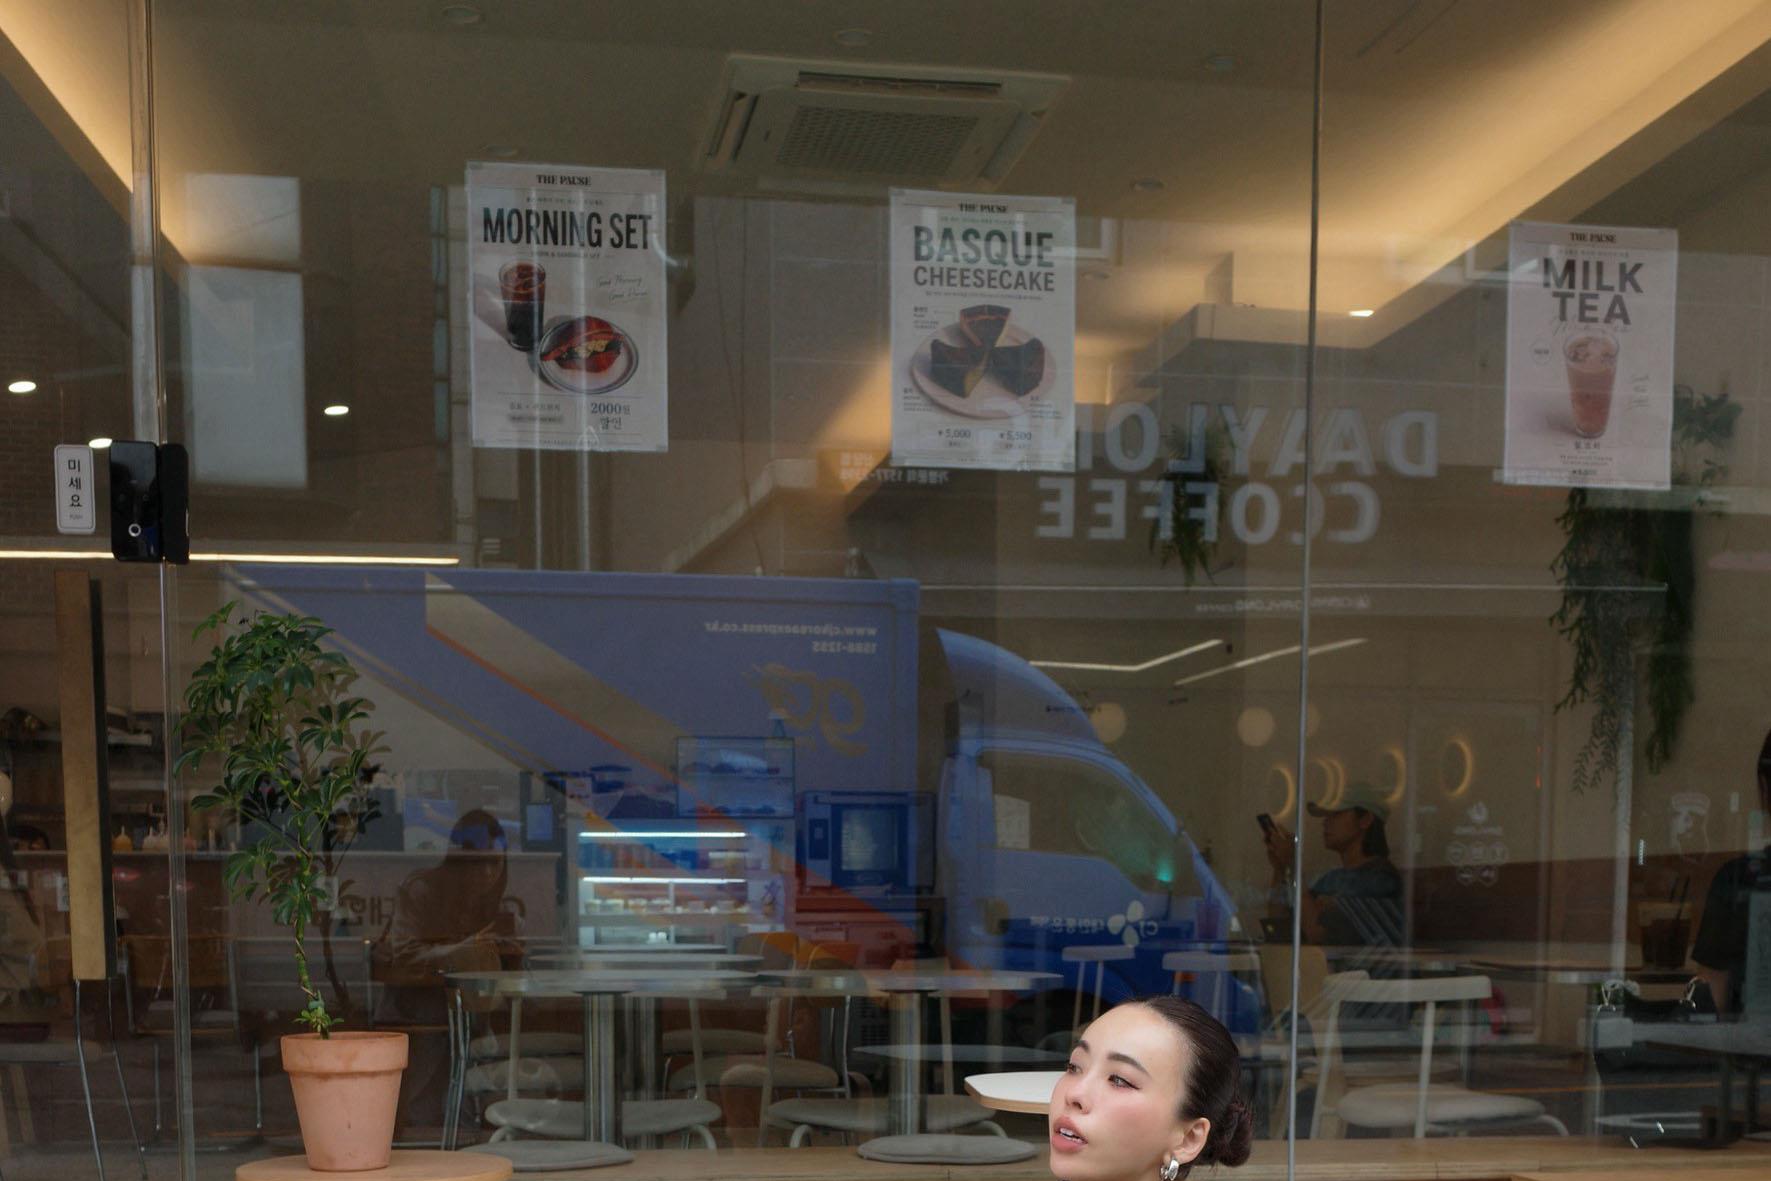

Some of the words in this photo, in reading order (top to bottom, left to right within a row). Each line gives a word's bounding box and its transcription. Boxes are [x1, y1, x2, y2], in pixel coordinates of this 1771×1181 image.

[536, 174, 558, 186] THE
[560, 174, 591, 187] PAUSE
[959, 203, 978, 213] THE
[980, 203, 1009, 214] PAUSE
[483, 207, 602, 248] MORNING
[609, 212, 652, 250] SET
[914, 225, 1055, 268] BASQUE
[1570, 232, 1588, 242] THE
[1590, 233, 1617, 243] PAUSE
[913, 265, 1055, 292] CHEESECAKE
[1543, 256, 1645, 294] MILK
[1551, 290, 1631, 326] TEA
[67, 458, 83, 508] 미세요
